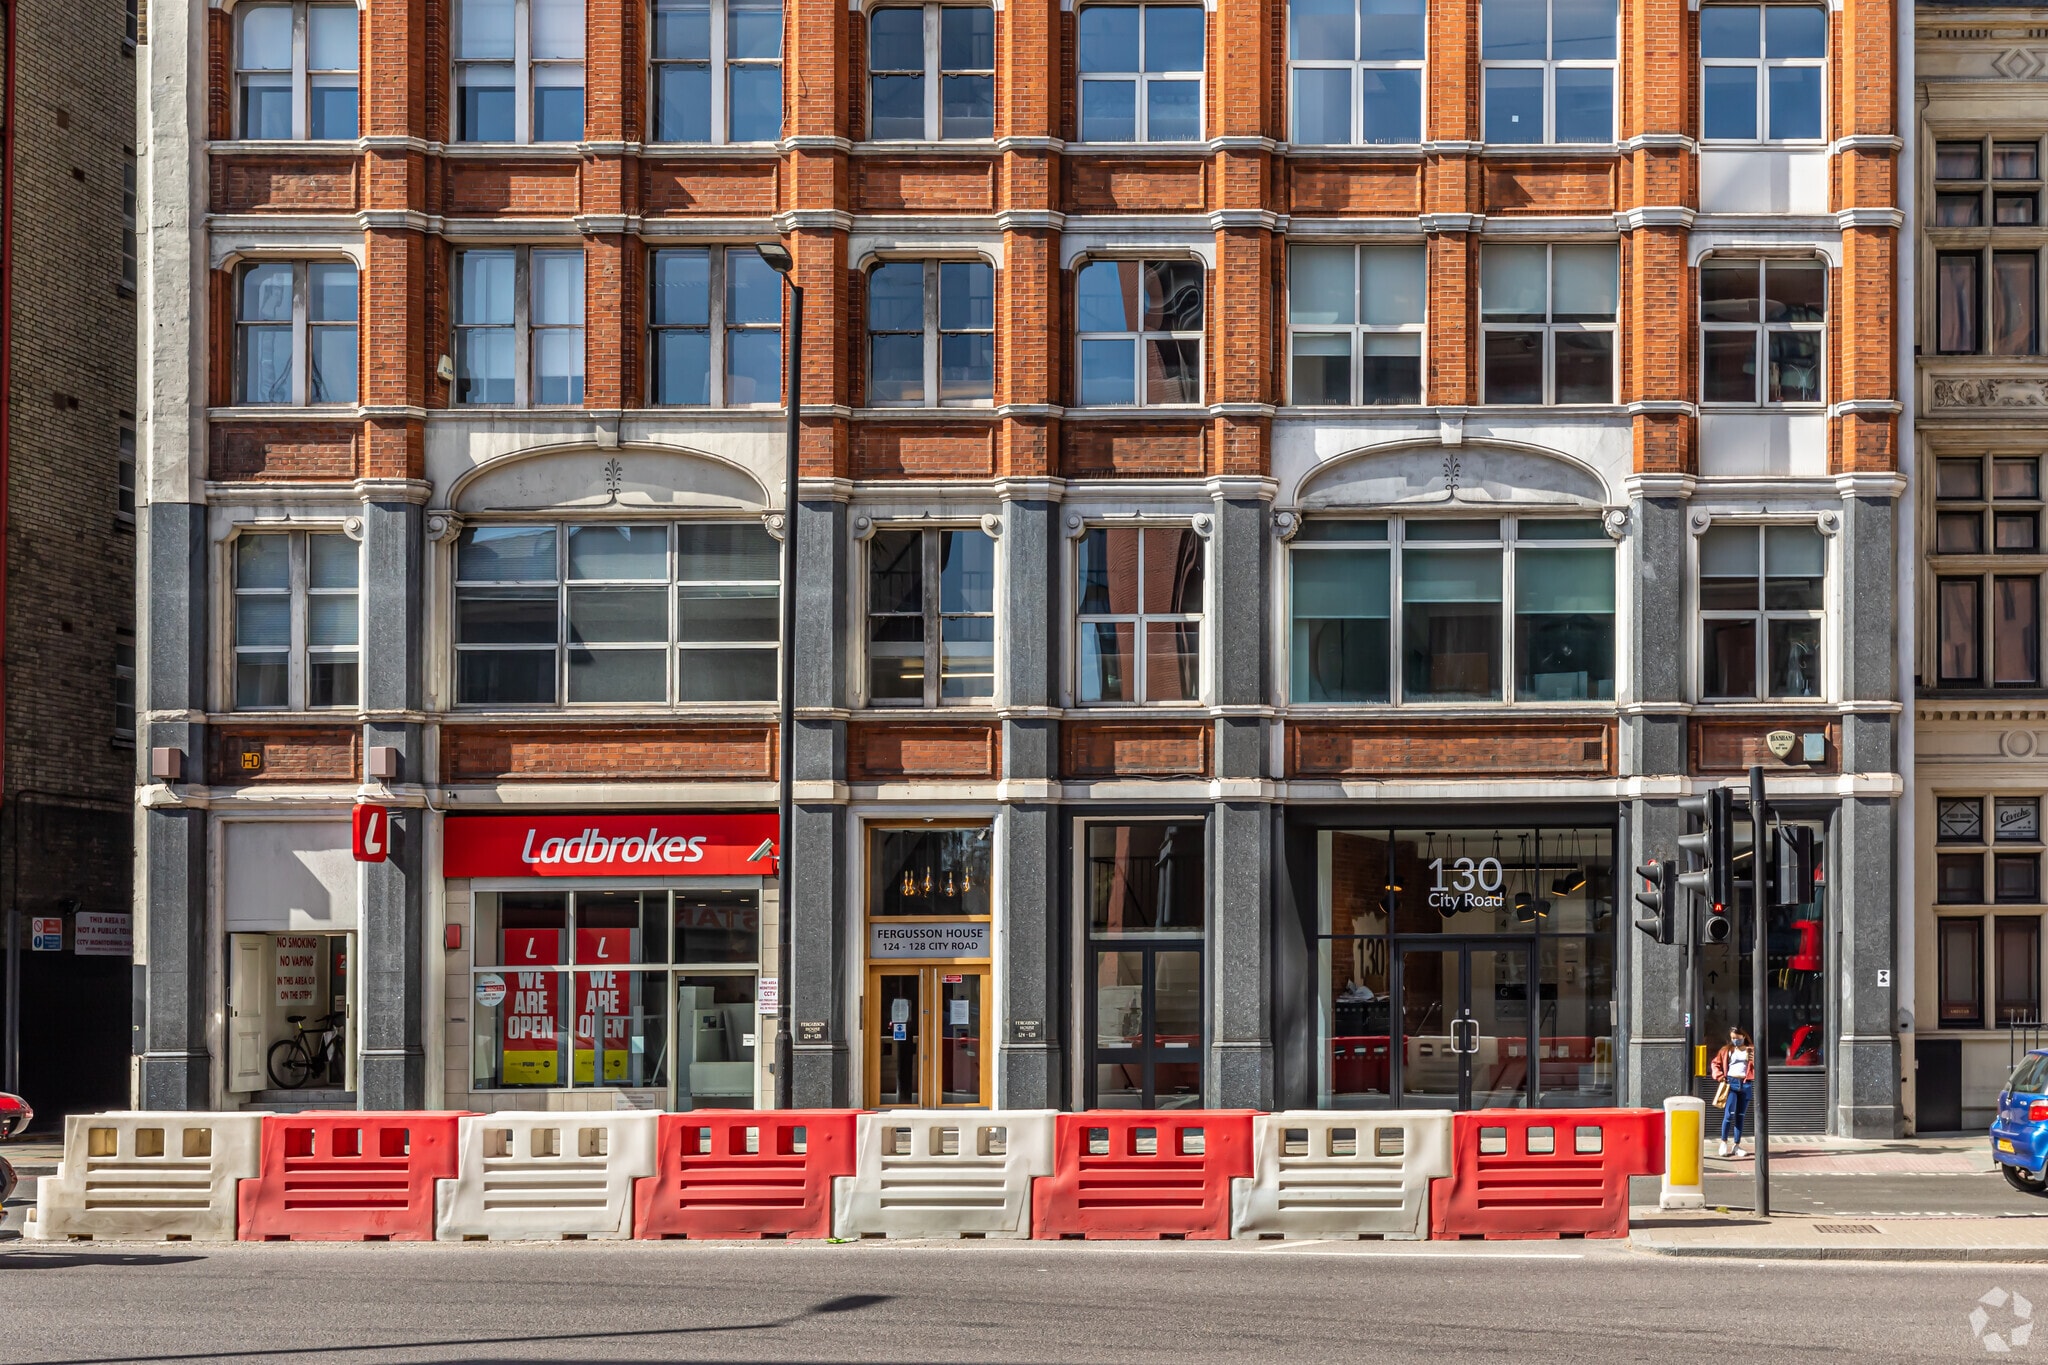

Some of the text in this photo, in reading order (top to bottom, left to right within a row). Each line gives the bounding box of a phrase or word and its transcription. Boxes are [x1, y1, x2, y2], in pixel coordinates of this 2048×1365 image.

[365, 812, 382, 855] L
[521, 828, 707, 864] Ladbrokes
[1428, 857, 1503, 892] 130
[1428, 892, 1503, 911] City Road
[97, 927, 118, 935] PUBLIC
[877, 928, 983, 939] FERGUSSON HOUSE
[277, 937, 317, 949] NO SMOKING
[526, 937, 537, 959] L
[597, 937, 609, 958] L
[883, 943, 900, 951] 124
[909, 942, 926, 951] 128
[928, 942, 949, 950] CITY
[951, 942, 978, 950] ROAD
[280, 955, 314, 967] NO VAPING
[1358, 938, 1385, 978] 130
[277, 976, 283, 985] IN
[283, 977, 294, 985] THIS
[295, 977, 307, 985] AREA
[517, 971, 545, 989] WE
[589, 971, 617, 989] WE
[281, 991, 312, 1000] ON THE STEPS
[1500, 987, 1508, 997] G
[514, 990, 548, 1014] ARE
[585, 990, 620, 1014] ARE
[507, 1016, 553, 1039] OPEN
[578, 1015, 624, 1038] OEN
